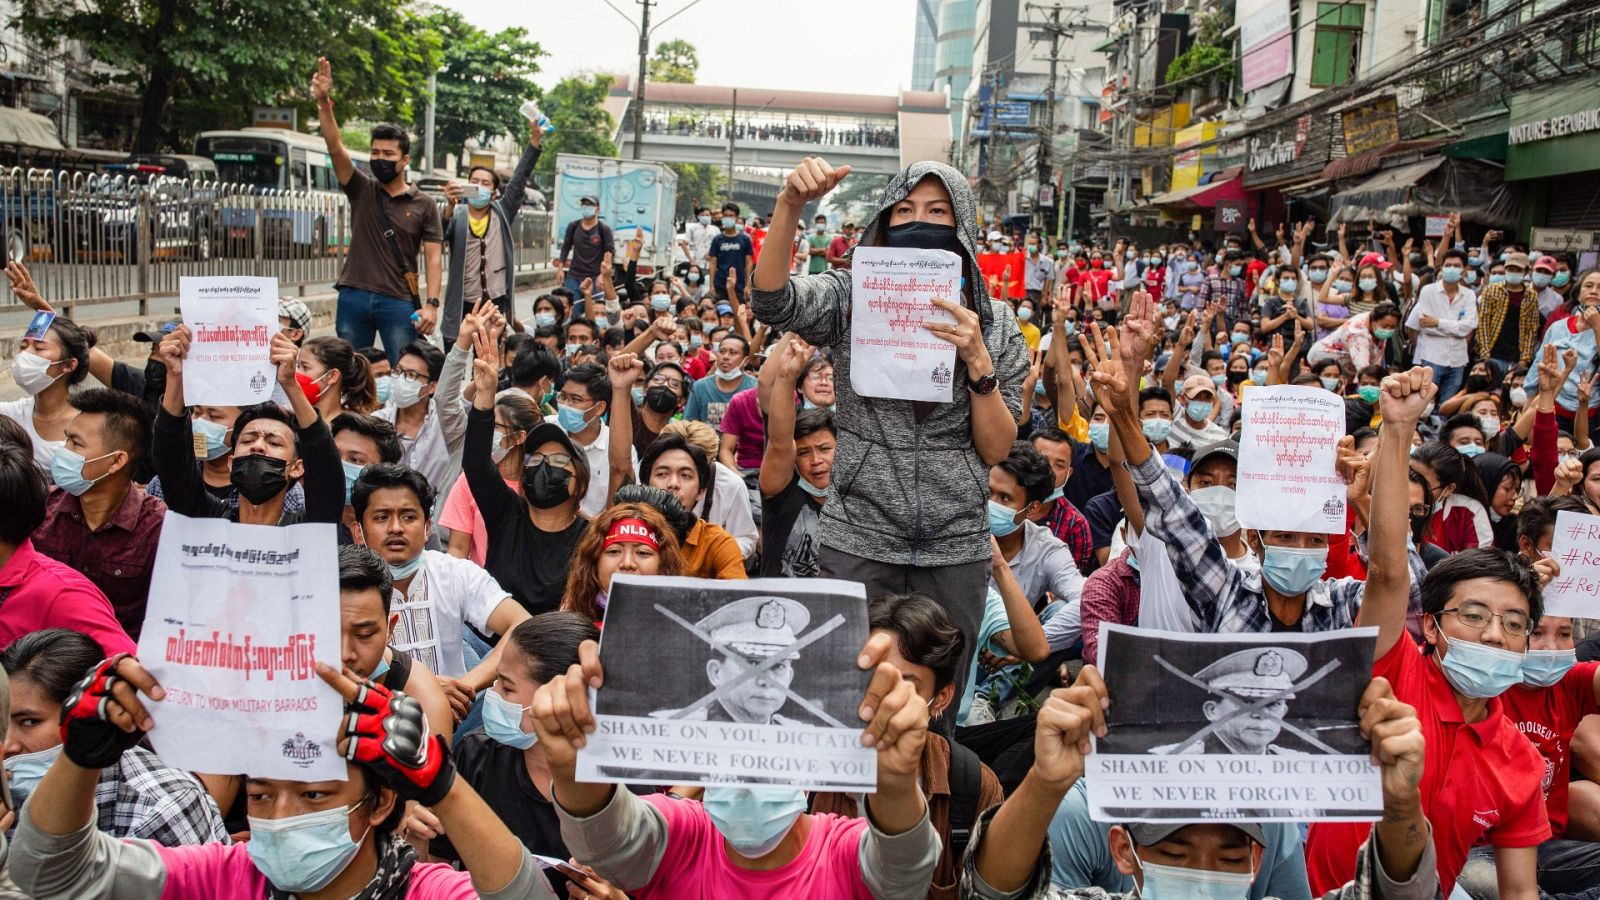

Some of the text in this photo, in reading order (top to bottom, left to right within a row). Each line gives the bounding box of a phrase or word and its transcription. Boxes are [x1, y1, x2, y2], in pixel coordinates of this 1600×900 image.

[1508, 120, 1548, 145] NATURE
[620, 524, 648, 537] NLD
[196, 694, 205, 709] TO
[208, 696, 231, 711] YOUR
[233, 699, 273, 712] MILITARY
[274, 696, 318, 713] BARRACKS
[600, 720, 866, 749] SHAME ON YOU, DICTATO
[612, 746, 872, 776] WE NEVER FORGIVE YOU
[1101, 759, 1376, 775] SHAME ON YOU, DICTATOR
[1112, 786, 1369, 802] WE NEVER FORGIVE YOU
